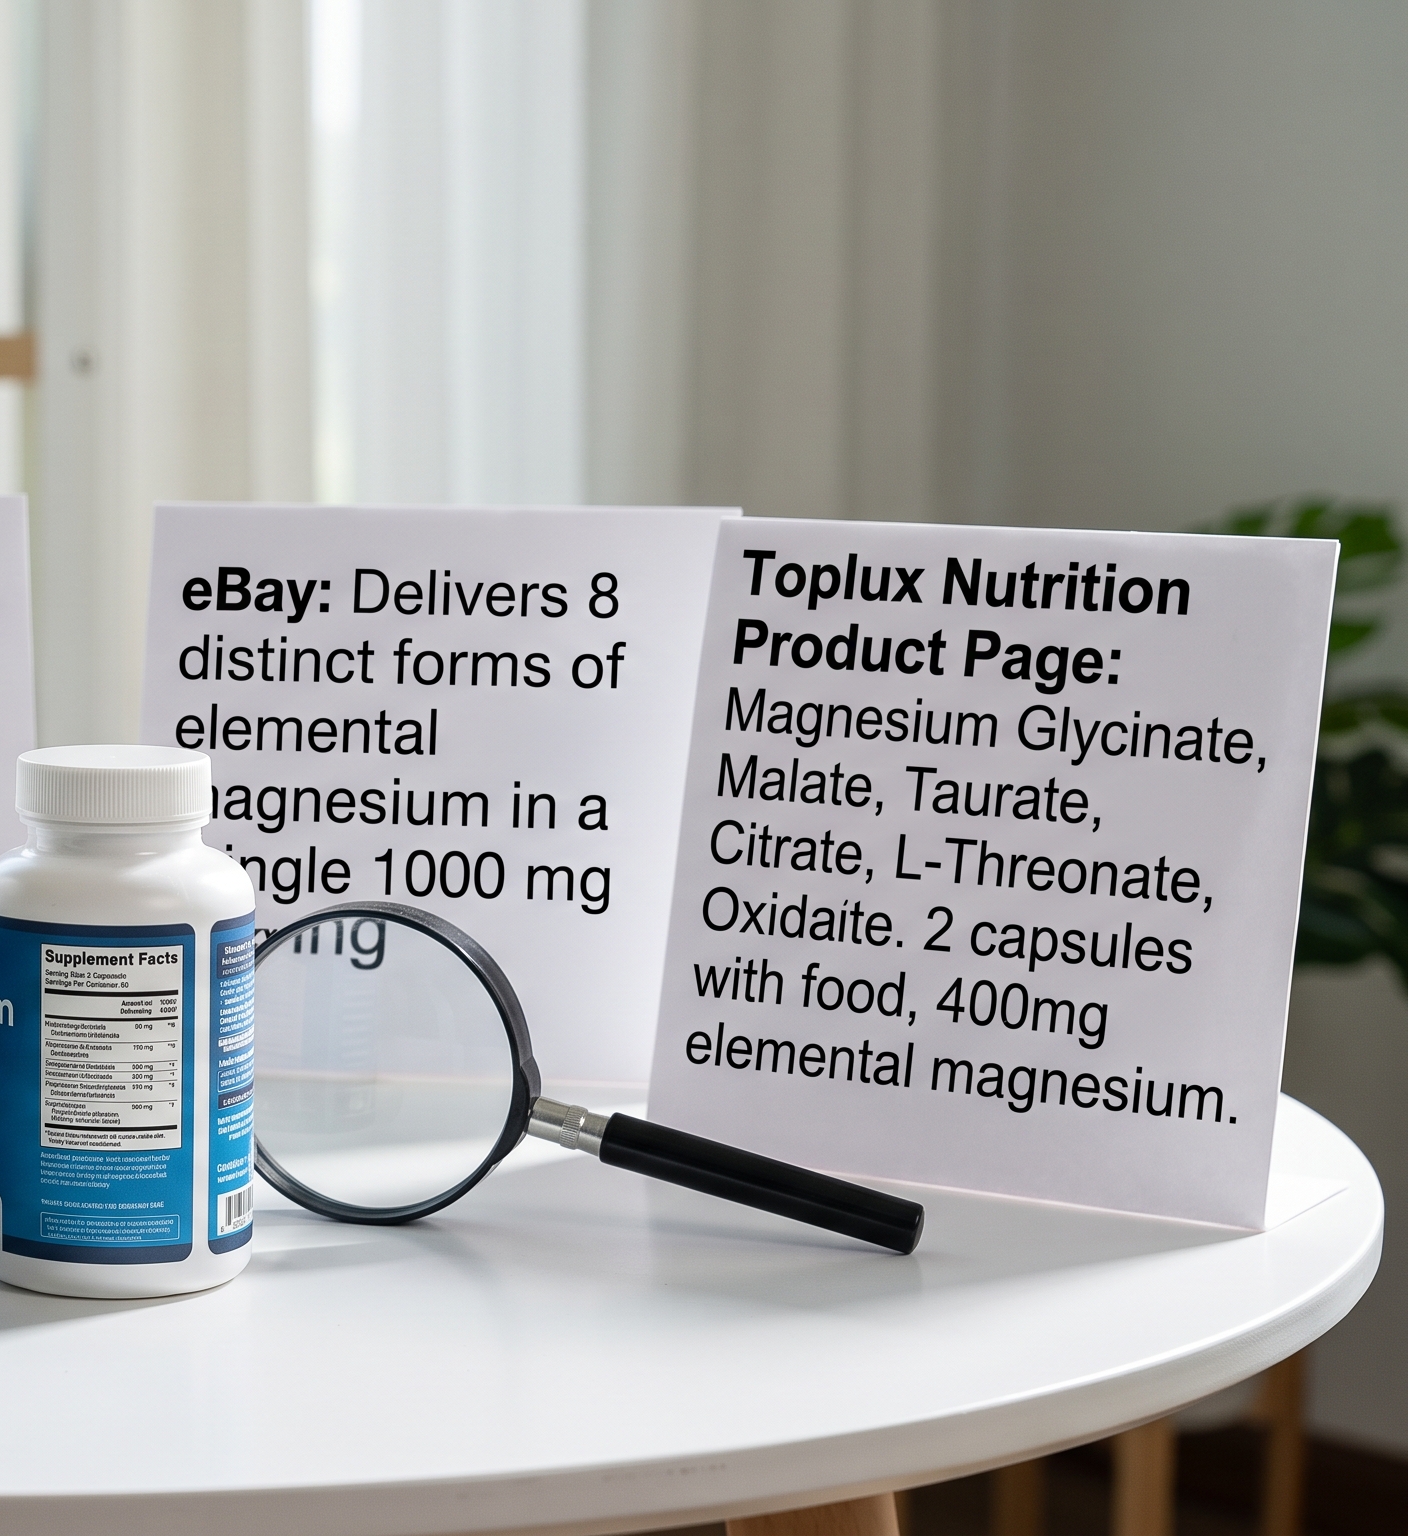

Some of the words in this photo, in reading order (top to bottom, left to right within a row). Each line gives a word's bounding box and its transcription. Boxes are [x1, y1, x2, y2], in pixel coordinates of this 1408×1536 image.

[183, 567, 330, 623] eBay:
[354, 569, 567, 617] Delivers
[589, 572, 618, 618] 8
[743, 550, 925, 610] Toplux
[943, 557, 1189, 615] Nutrition
[179, 634, 374, 683] distinct
[394, 638, 550, 687] forms
[572, 642, 626, 688] of
[734, 619, 946, 675] Product
[964, 630, 1121, 694] Page:
[176, 704, 437, 755] elemental
[726, 687, 997, 748] Magnesium
[1018, 705, 1265, 773] Glycinate,
[513, 781, 555, 829] in
[579, 795, 608, 830] a
[718, 753, 883, 816] Malate,
[906, 766, 1100, 832] Taurate,
[375, 849, 504, 899] 1000
[527, 866, 610, 914] mg
[711, 820, 873, 884] Citrate,
[896, 834, 1212, 913] L-Threonate,
[45, 949, 134, 967] Supplement
[138, 952, 178, 965] Facts
[924, 906, 953, 952] 2
[971, 922, 1192, 974] capsules
[694, 957, 783, 1004] with
[802, 963, 916, 1026] food,
[937, 978, 1108, 1049] 400mg
[686, 1022, 914, 1087] elemental
[931, 1058, 1236, 1124] magnesium.
